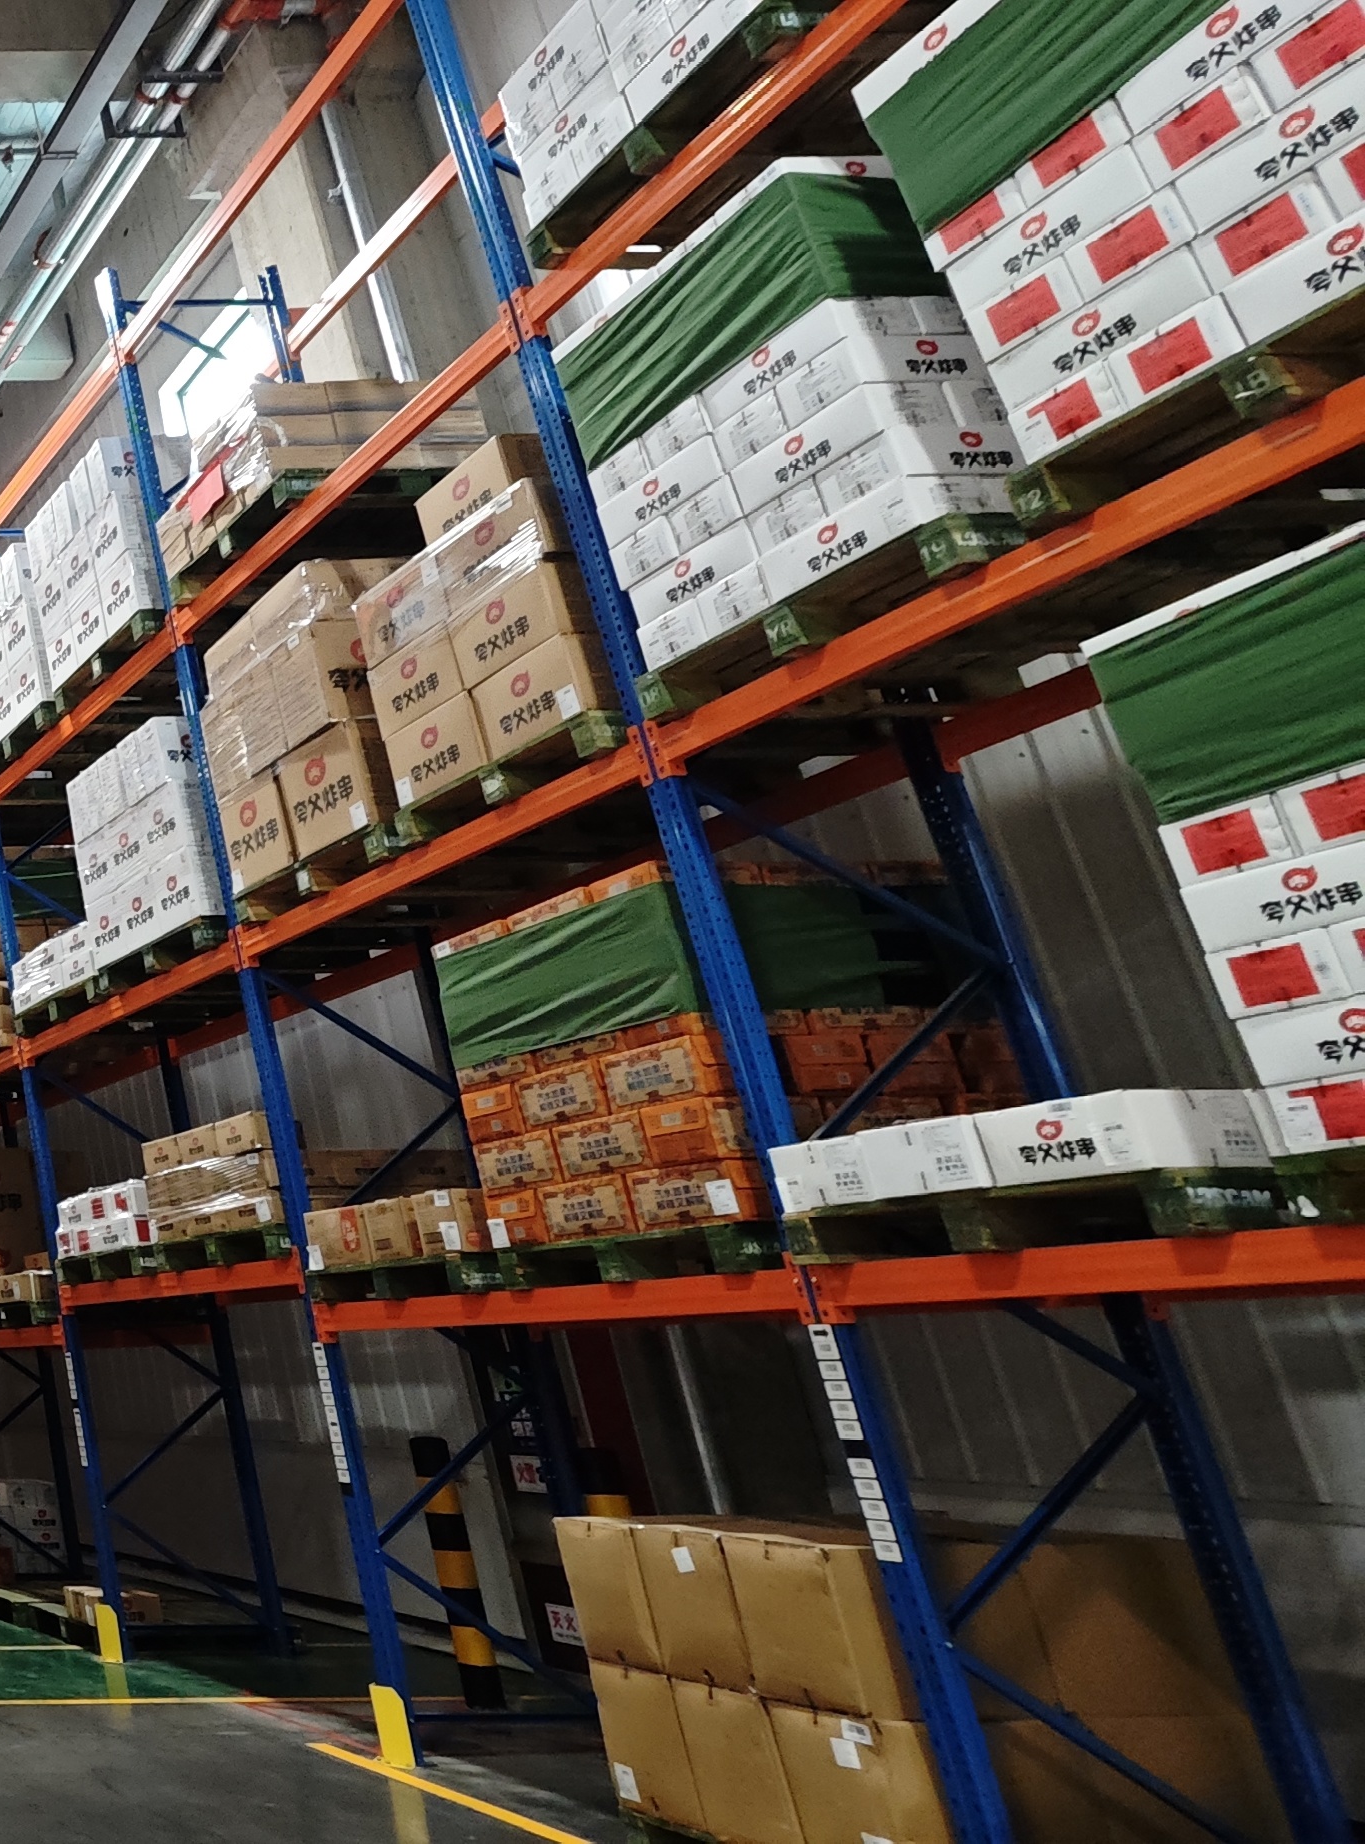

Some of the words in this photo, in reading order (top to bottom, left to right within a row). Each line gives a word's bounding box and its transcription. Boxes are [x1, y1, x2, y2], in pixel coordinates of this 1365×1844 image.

[1186, 6, 1284, 81] 夸父炸串
[1254, 106, 1361, 182] 夸父炸串
[1003, 214, 1083, 276] 夸父炸串
[1052, 314, 1138, 374] 夸父炸串
[742, 348, 799, 397] 夸父炸串
[775, 438, 833, 485] 夸父炸串
[806, 531, 869, 574] 夸父炸串
[665, 566, 716, 604] 夸父炸串
[474, 615, 532, 663] 夸父炸串
[391, 670, 440, 714] 夸父炸串
[499, 690, 557, 737] 夸父炸串
[410, 744, 462, 785] 夸父炸串
[293, 774, 356, 826] 夸父炸串
[230, 818, 281, 862] 夸父炸串
[1259, 880, 1364, 923] 夸父炸串
[1018, 1137, 1097, 1166] 夸父炸串
